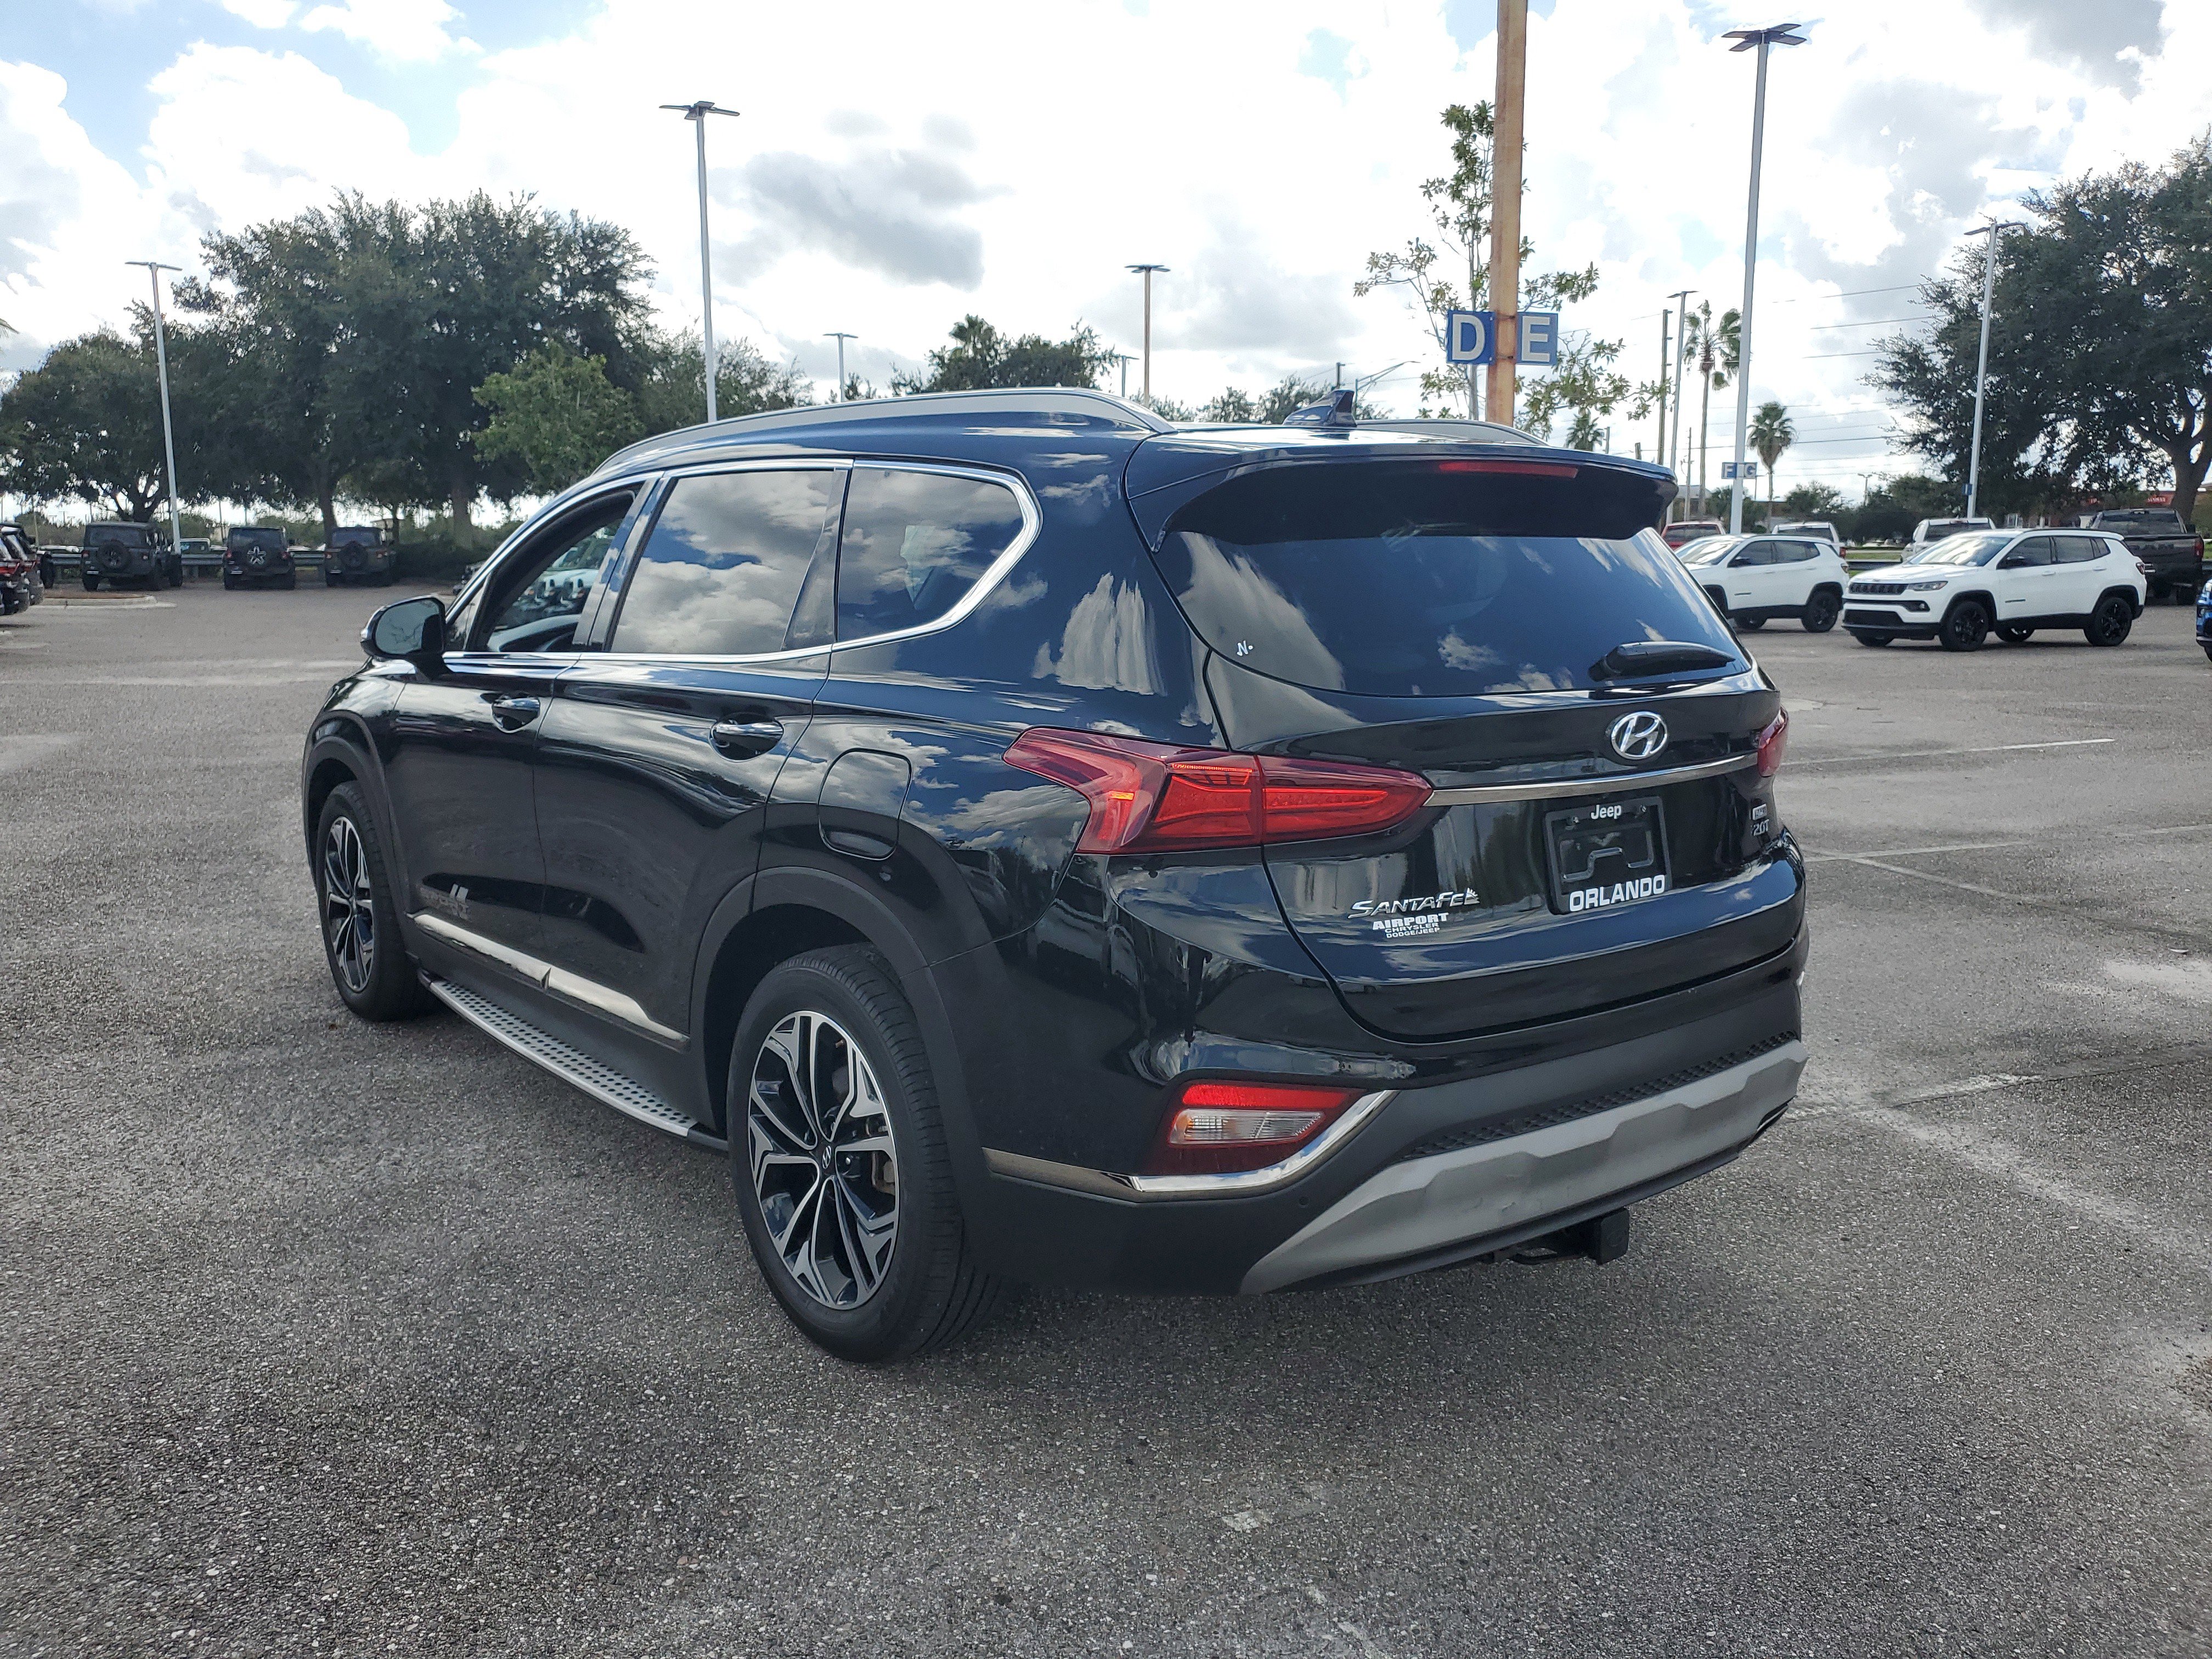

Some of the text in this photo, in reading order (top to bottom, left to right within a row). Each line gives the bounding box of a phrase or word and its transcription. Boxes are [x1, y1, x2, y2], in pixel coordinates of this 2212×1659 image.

[1452, 313, 1486, 360] D
[1521, 315, 1550, 362] E
[1724, 464, 1734, 477] F
[1745, 464, 1756, 477] G
[1590, 804, 1622, 819] Jeep
[1570, 874, 1666, 912] ORLANDO
[1372, 912, 1449, 930] AIRPORT
[1384, 922, 1440, 934] CHRYSLER
[1386, 927, 1441, 939] DODGE/JEEP
